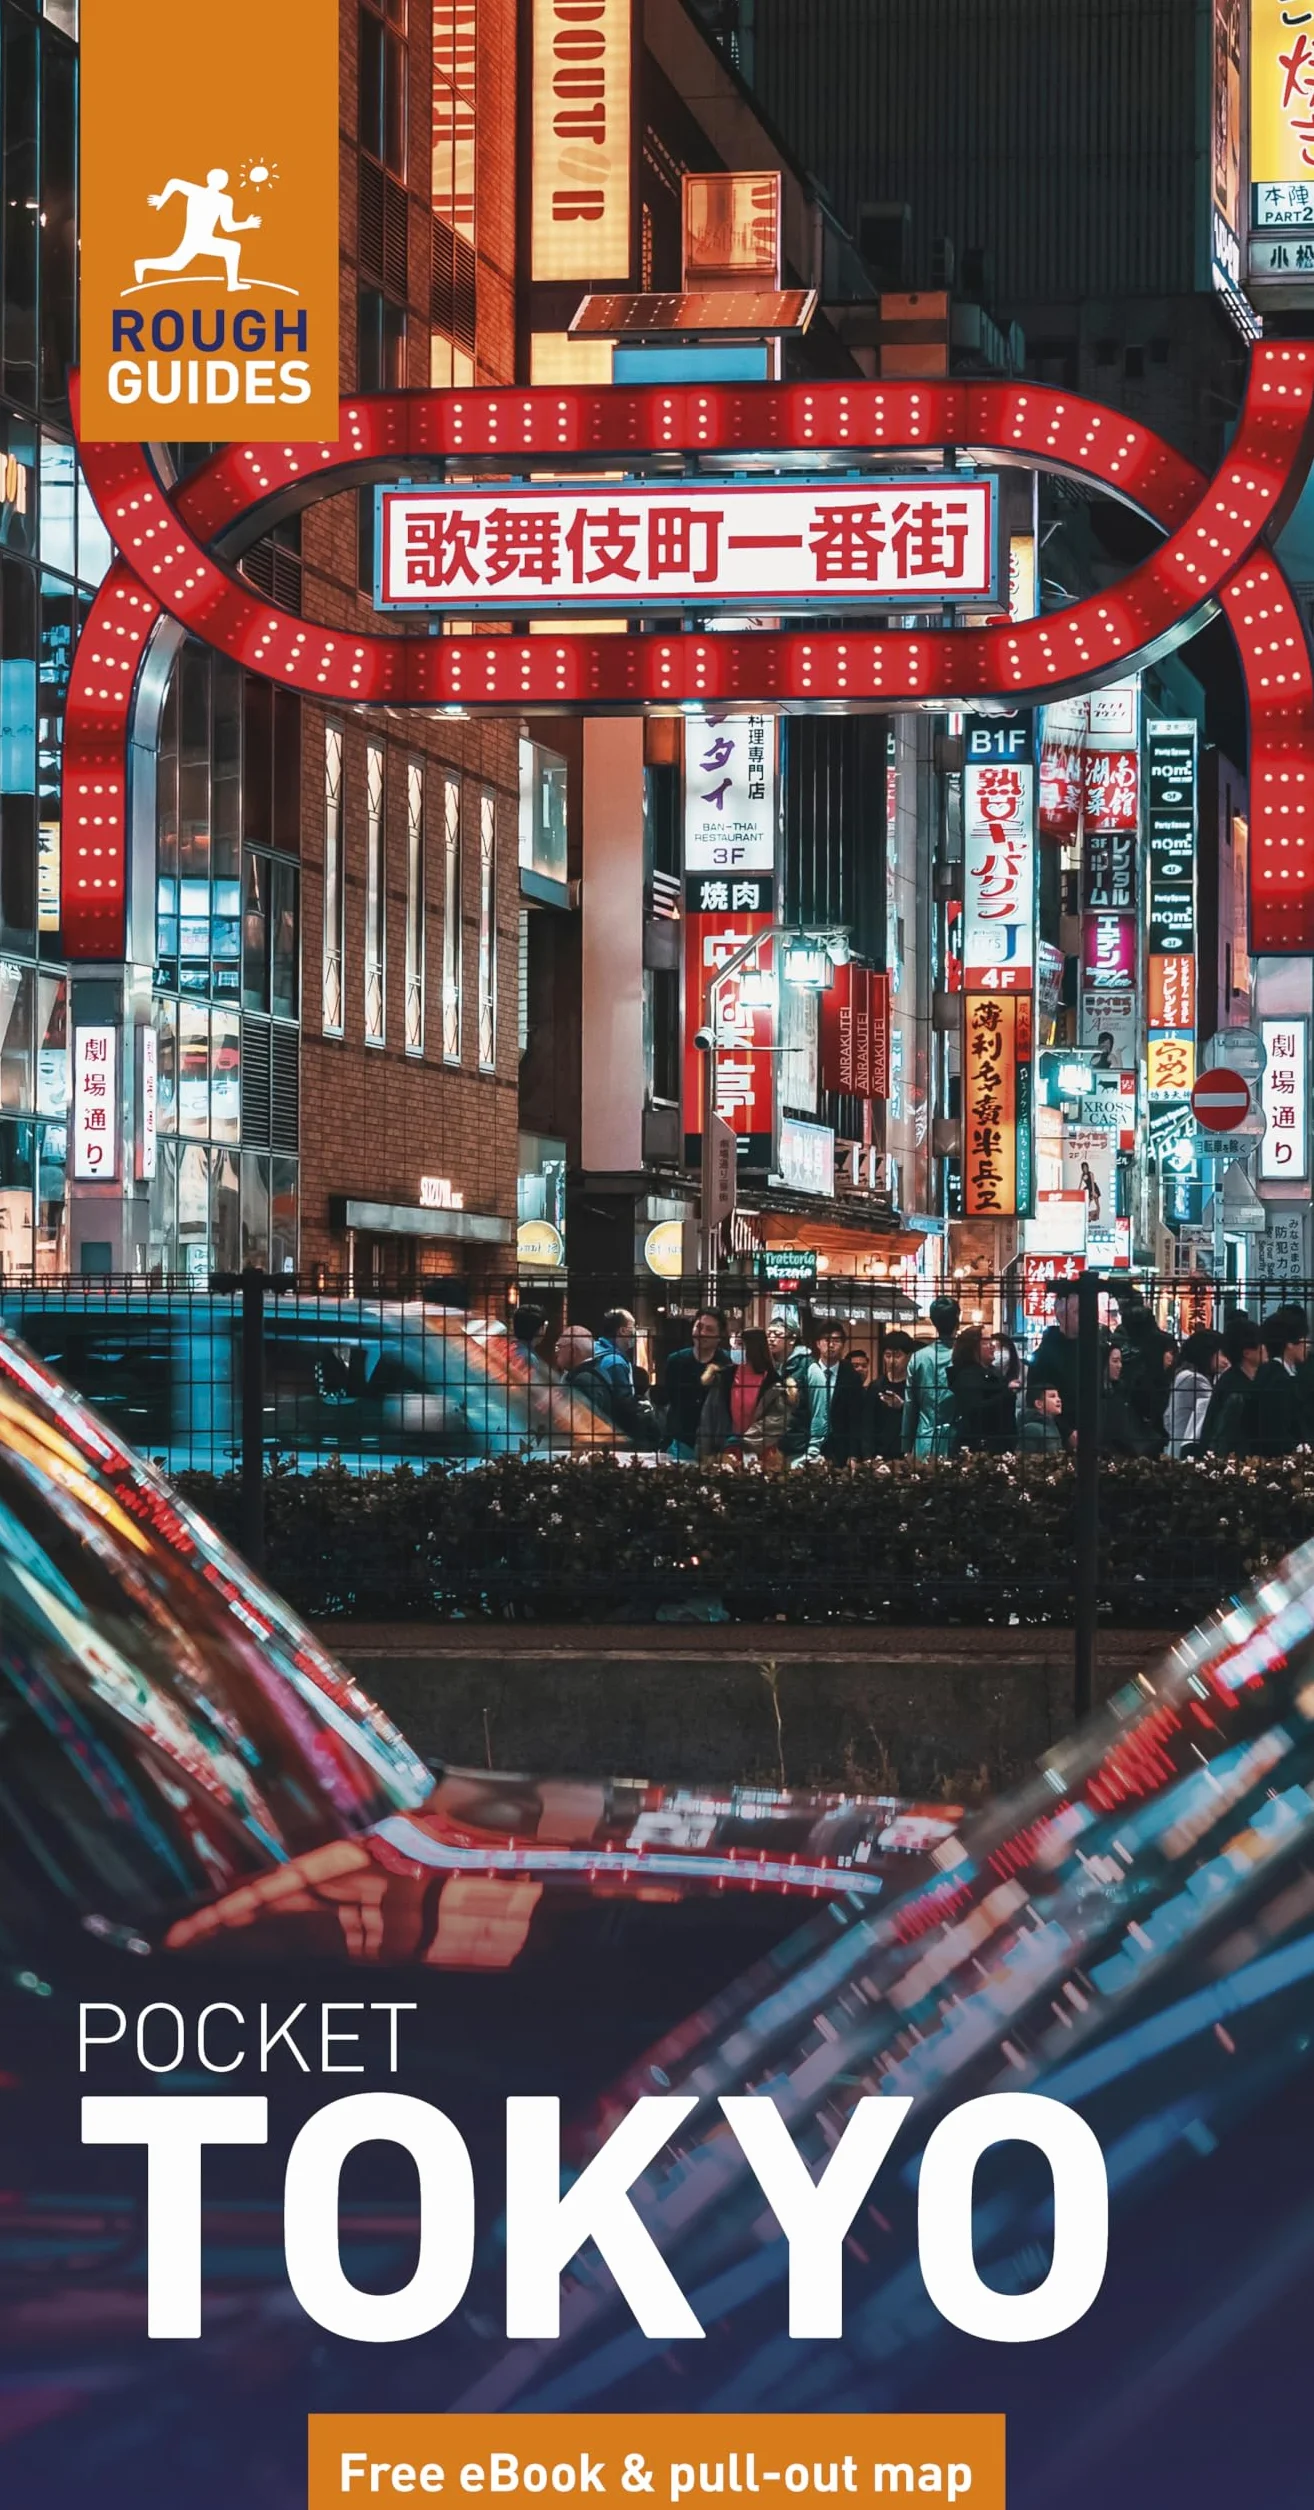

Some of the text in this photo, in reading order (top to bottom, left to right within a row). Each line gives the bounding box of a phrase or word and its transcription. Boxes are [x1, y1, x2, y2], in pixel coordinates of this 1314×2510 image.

[1265, 185, 1309, 206] 本陣
[1265, 207, 1313, 222] PART2
[405, 502, 968, 587] 歌舞伎町一番街
[971, 730, 1026, 753] B1F
[1085, 756, 1136, 787] 湖南
[695, 833, 764, 841] RESTAURANT
[703, 823, 757, 831] BAN-THAI
[713, 848, 745, 864] 3F
[1112, 837, 1130, 905] レンタル
[700, 881, 760, 911] 焼肉
[981, 970, 1016, 989] 4F
[840, 1006, 852, 1086] ANRAKUTEI
[857, 1013, 869, 1091] ANRAKUTEI
[874, 1018, 885, 1095] ANRAKUTEI
[84, 1039, 107, 1165] 劇場通り
[1084, 1102, 1132, 1112] XROSS
[1271, 1034, 1296, 1164] 劇場通り
[1089, 1113, 1127, 1124] CASA
